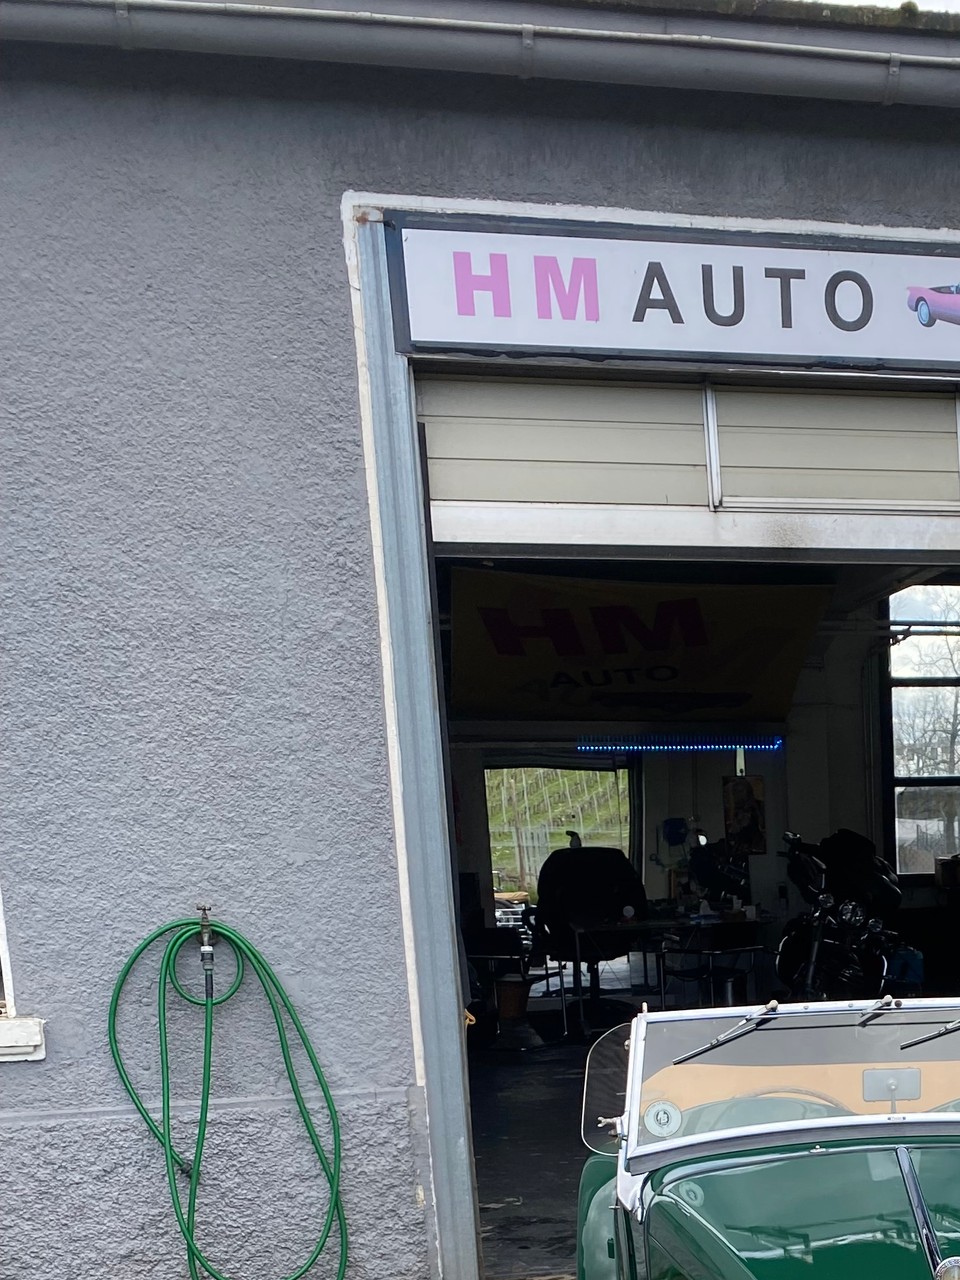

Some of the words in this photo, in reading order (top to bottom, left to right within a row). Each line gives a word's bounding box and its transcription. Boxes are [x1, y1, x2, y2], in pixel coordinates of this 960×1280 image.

[453, 251, 600, 322] HM
[632, 261, 874, 332] AUTO
[477, 597, 709, 657] HM
[550, 664, 680, 689] AUTO
